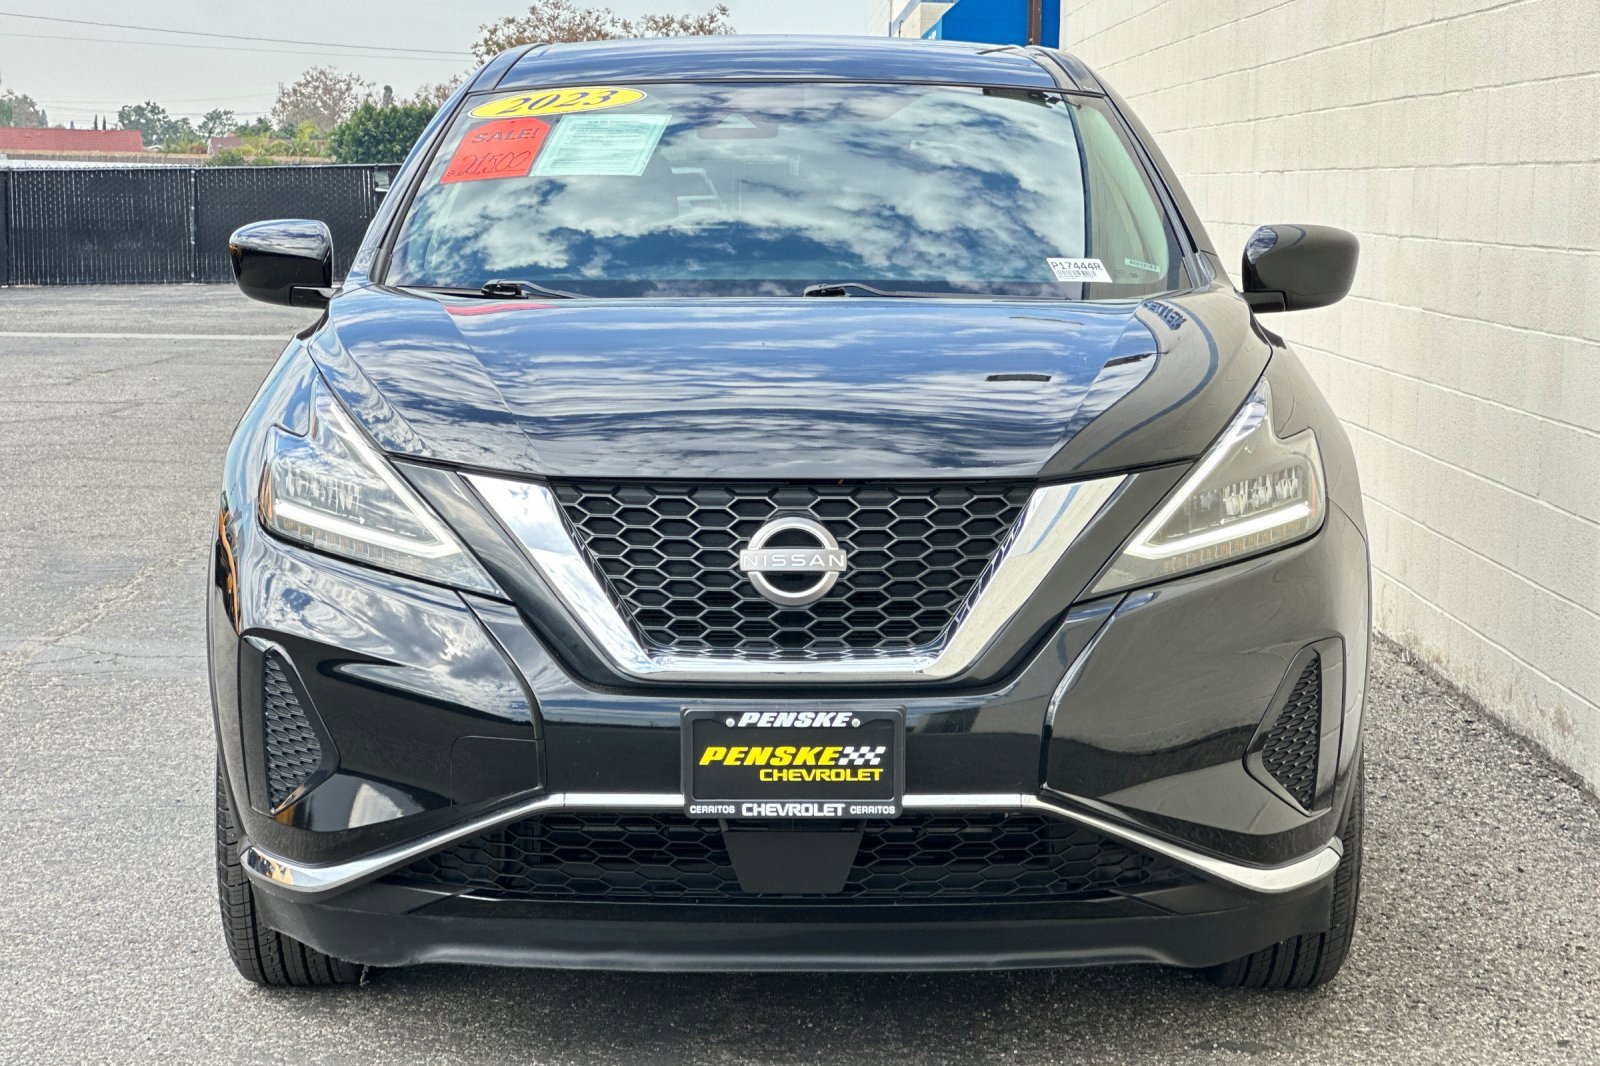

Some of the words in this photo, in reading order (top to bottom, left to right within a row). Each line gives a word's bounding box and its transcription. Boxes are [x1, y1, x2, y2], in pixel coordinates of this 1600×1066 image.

[496, 90, 618, 115] 2023
[472, 127, 540, 144] SALE!
[1050, 261, 1103, 271] P17444R
[743, 554, 845, 568] NISSAN
[737, 711, 853, 728] PENSKE
[699, 746, 844, 766] PENSKE
[759, 768, 884, 782] CHEVROLET
[690, 804, 736, 815] CERRITOS
[742, 803, 846, 817] CHEVROLET
[849, 804, 896, 815] CERRITOS
